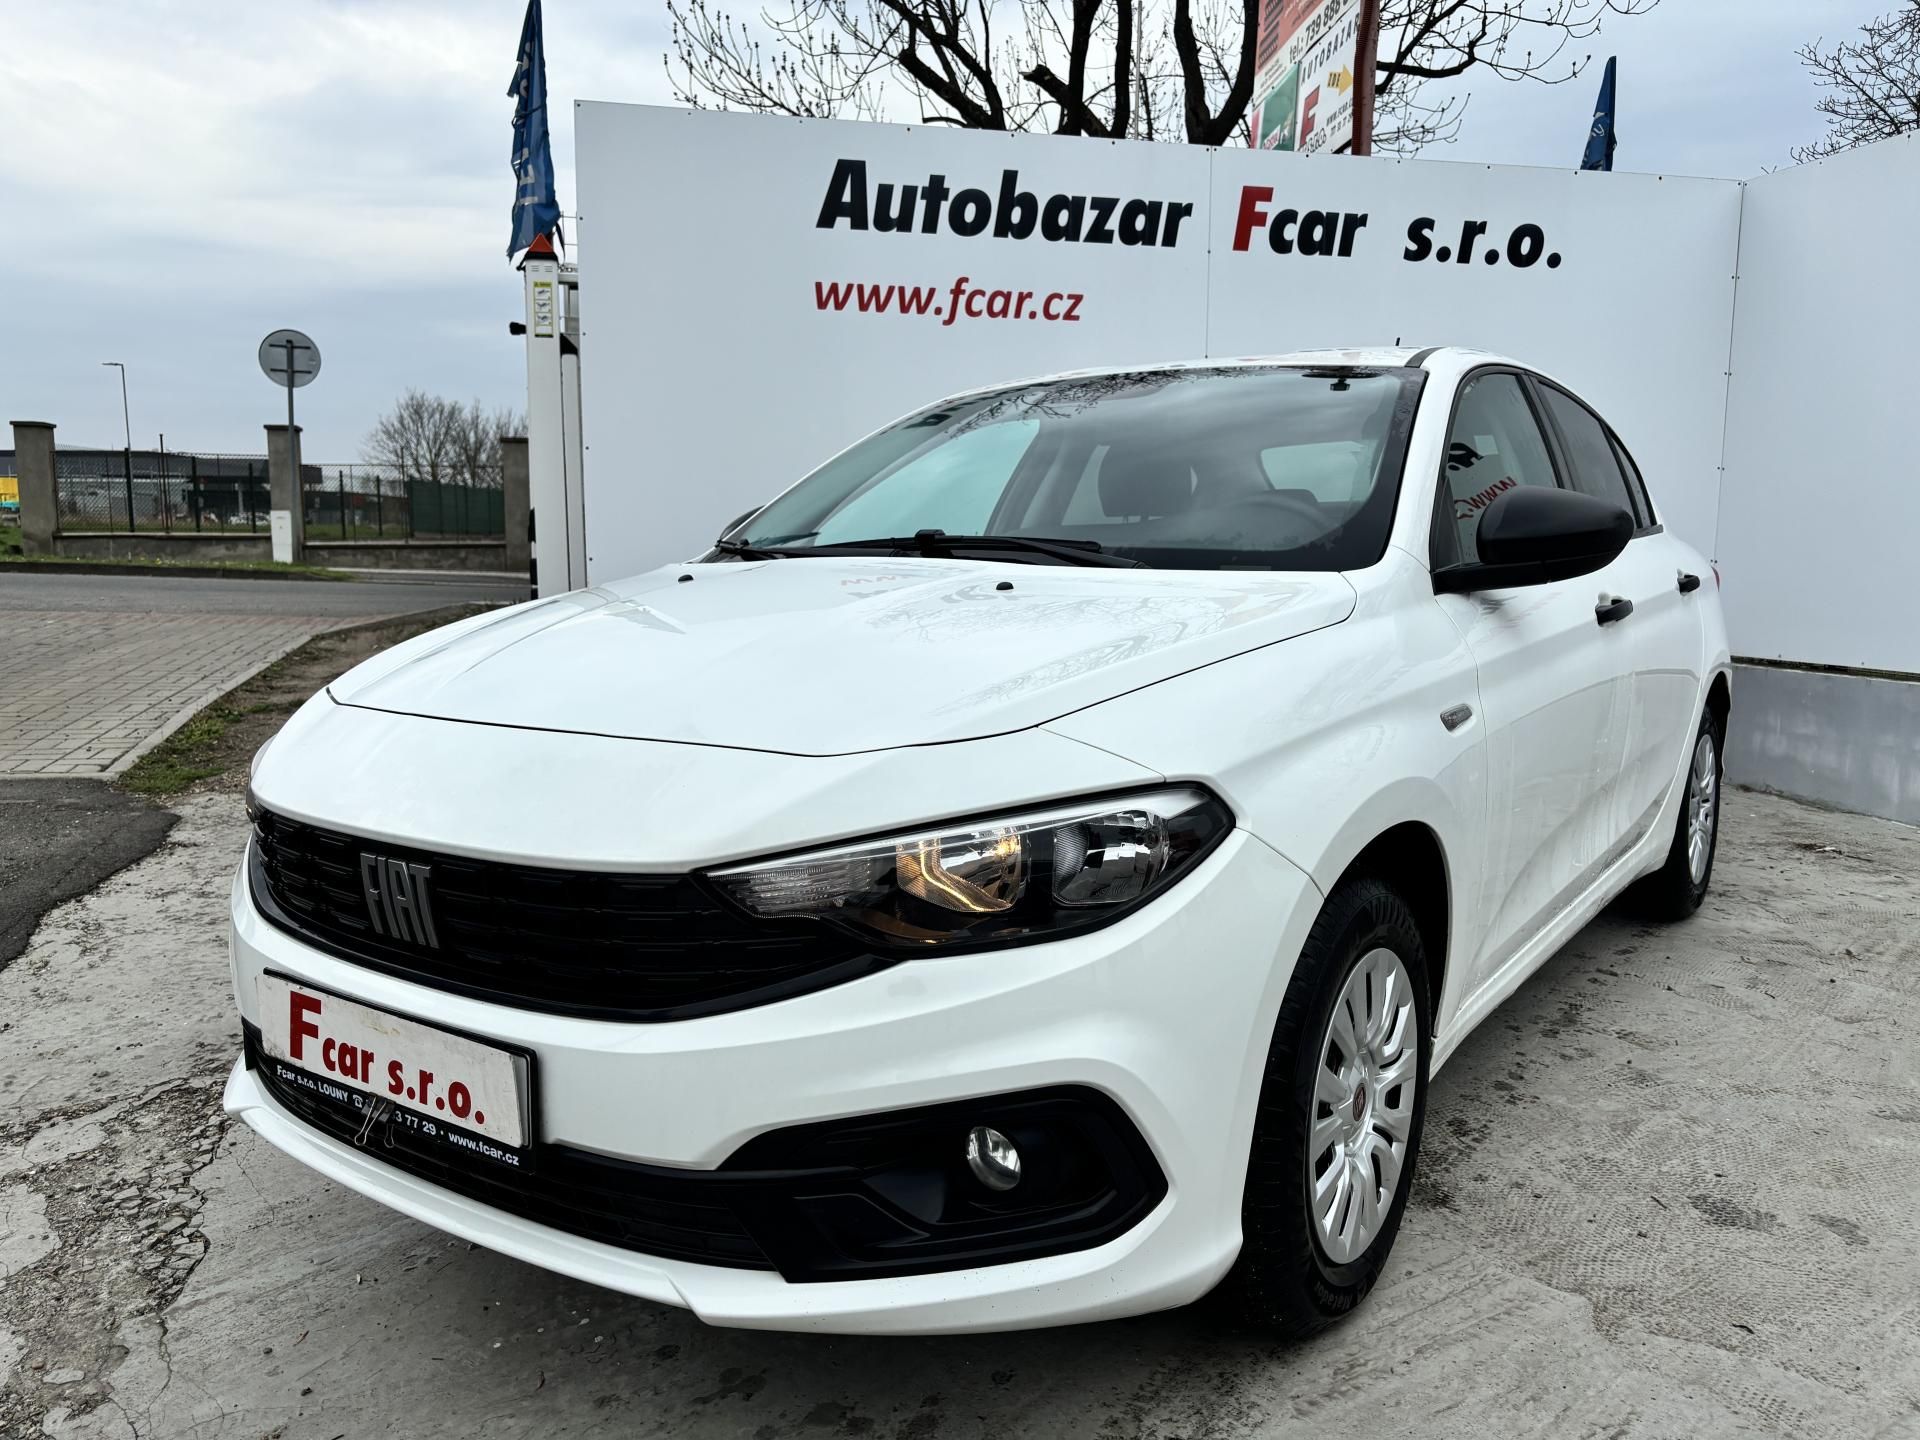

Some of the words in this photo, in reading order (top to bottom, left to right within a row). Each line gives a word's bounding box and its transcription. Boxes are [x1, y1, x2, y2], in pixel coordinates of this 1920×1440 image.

[1301, 12, 1360, 86] AUTOBAZAR
[1306, 13, 1321, 47] 739
[1329, 72, 1341, 88] ZDE
[815, 158, 1193, 248] Autobazar
[1232, 185, 1369, 258] Fcar
[1403, 217, 1562, 269] s.r.o.
[815, 277, 1084, 326] www.fcar.cz
[359, 851, 440, 949] FIAT
[289, 990, 375, 1084] Fcar
[387, 1059, 485, 1125] s.r.o.
[276, 1064, 295, 1081] Fcar
[297, 1075, 317, 1090] s.r.o.
[318, 1081, 348, 1102] LOUNY
[404, 1114, 418, 1129] 77
[422, 1121, 436, 1135] 29
[448, 1132, 519, 1165] www.fcar.cz
